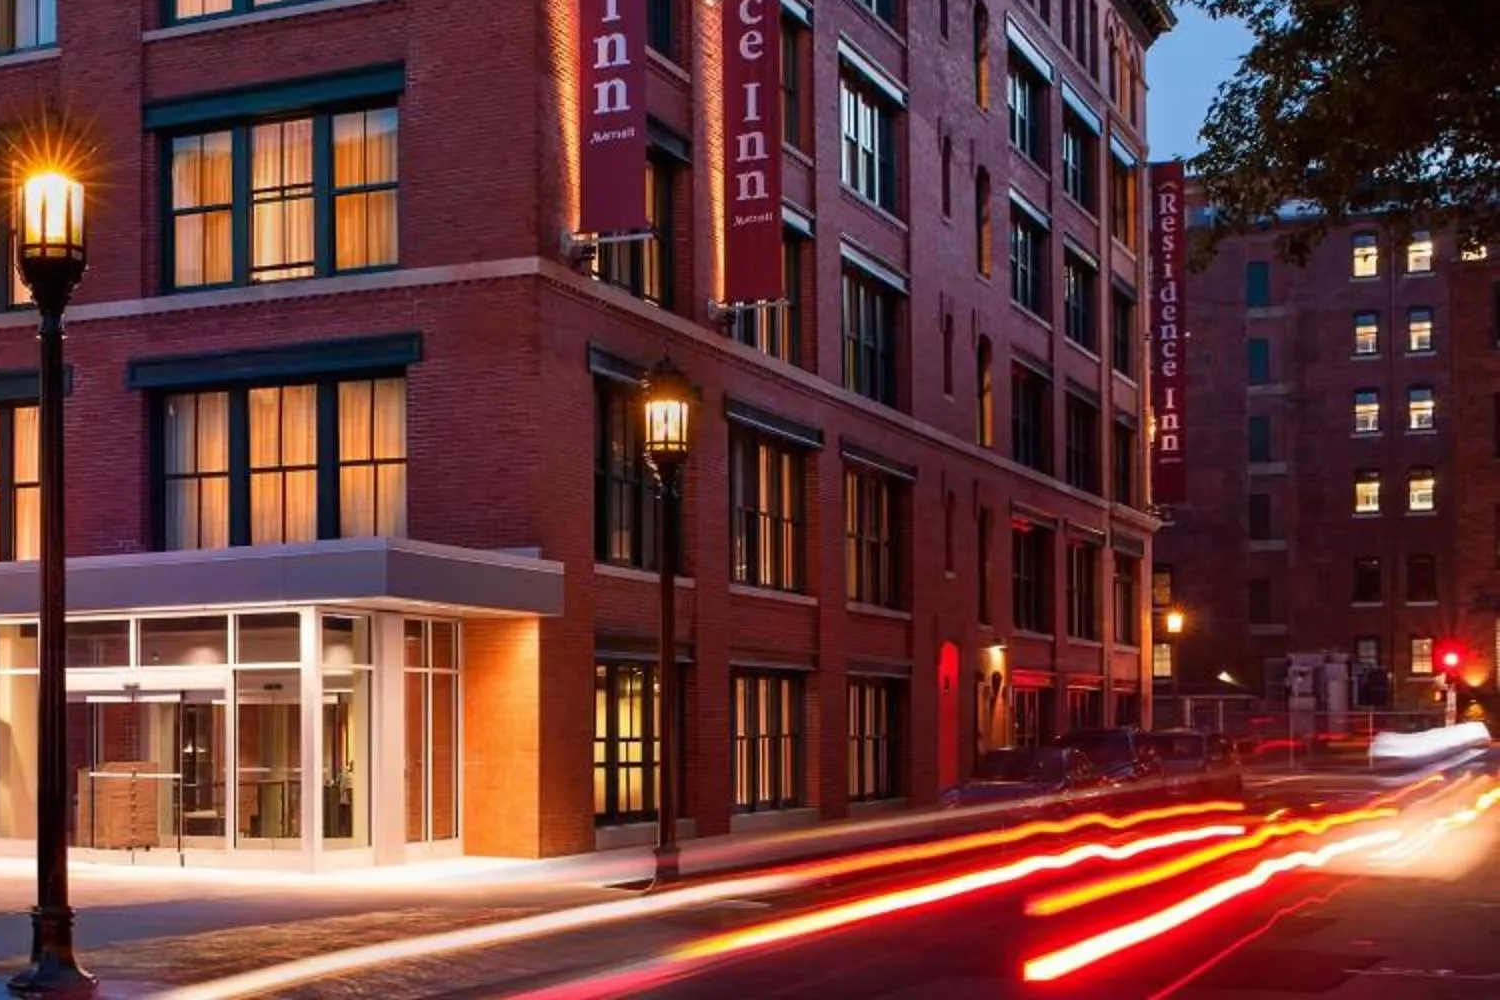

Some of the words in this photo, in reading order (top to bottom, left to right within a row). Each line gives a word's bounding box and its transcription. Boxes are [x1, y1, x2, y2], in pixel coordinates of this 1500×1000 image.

[735, 82, 770, 201] Inn
[1158, 193, 1178, 377] Residence
[1160, 387, 1180, 451] Inn
